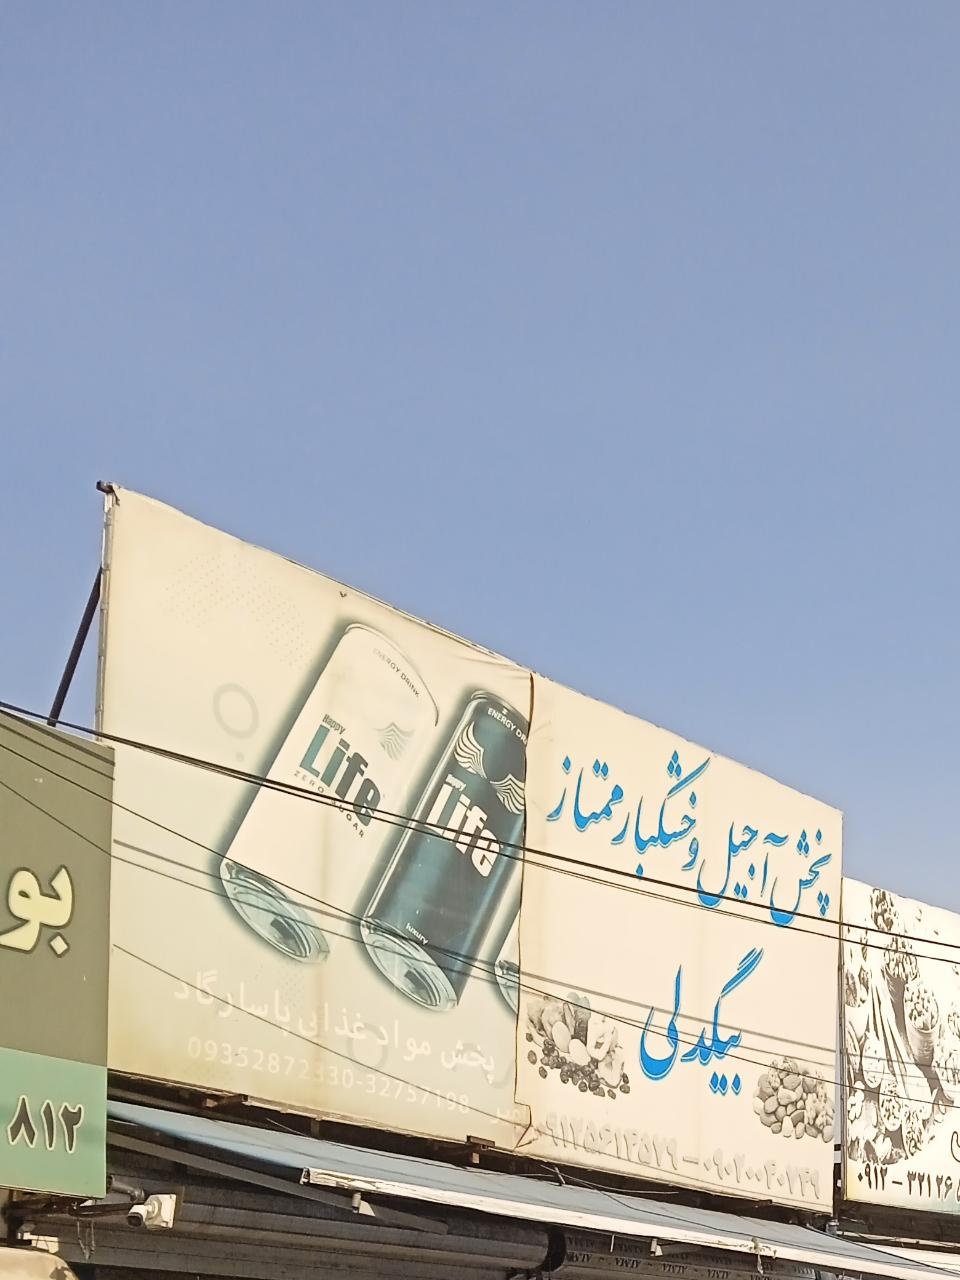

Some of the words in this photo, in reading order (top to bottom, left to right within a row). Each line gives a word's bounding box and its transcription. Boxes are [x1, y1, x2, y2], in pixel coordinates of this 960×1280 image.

[322, 714, 346, 735] Happy
[487, 707, 516, 731] ENERGY
[294, 770, 325, 794] ZERO
[299, 724, 381, 827] Life
[546, 754, 625, 833] ممتاز
[424, 783, 500, 877] Life
[611, 750, 712, 880] خشکبار
[680, 837, 700, 872] و
[697, 820, 790, 908] آجیل
[769, 828, 834, 928] پخش
[406, 922, 429, 945] luxury
[376, 1021, 432, 1063] مواد
[638, 946, 764, 1096] بیگدلی
[441, 1039, 497, 1084] پخش
[7, 1095, 83, 1153] ۸۱۲
